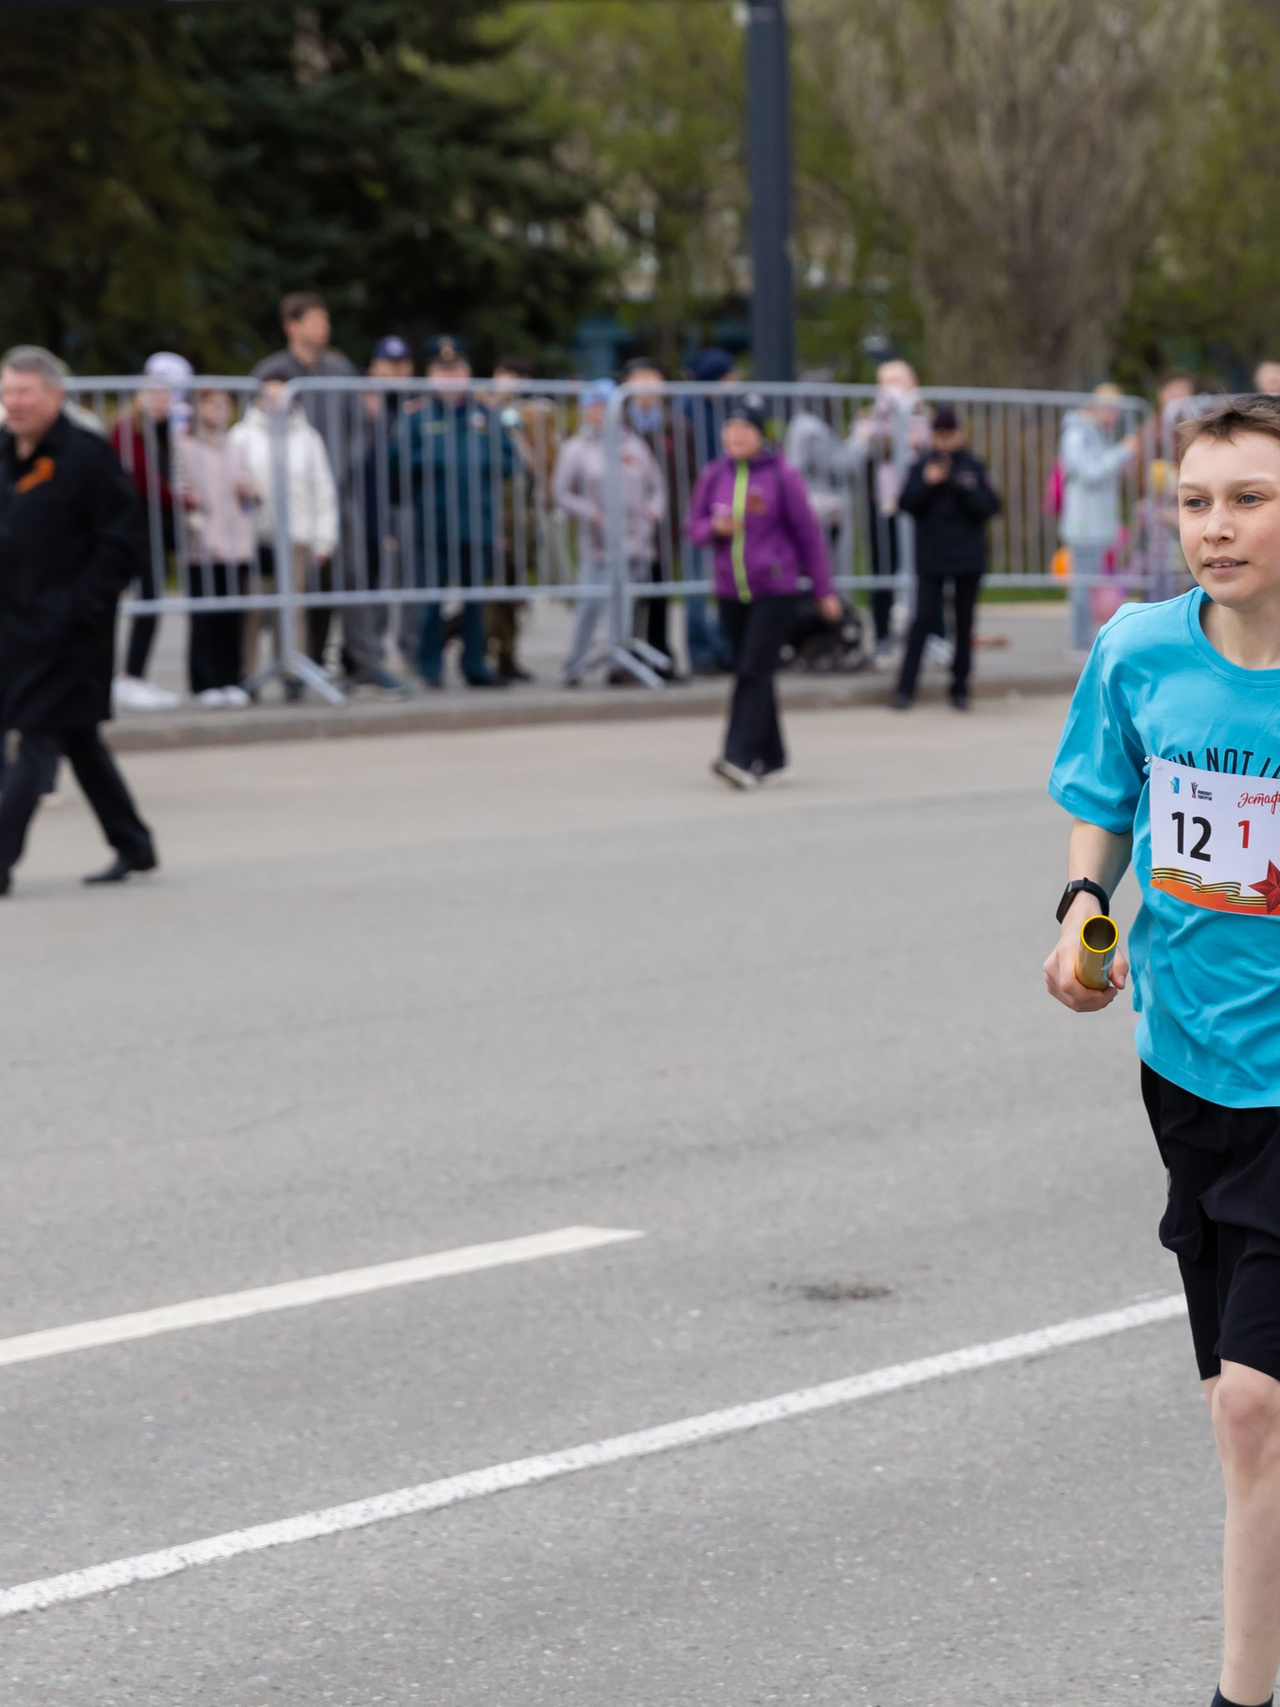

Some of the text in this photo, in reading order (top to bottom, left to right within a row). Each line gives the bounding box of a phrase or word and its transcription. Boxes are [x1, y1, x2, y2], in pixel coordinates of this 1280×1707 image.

[1206, 747, 1254, 776] NOT
[1171, 811, 1212, 862] 12
[1237, 819, 1250, 849] 1
